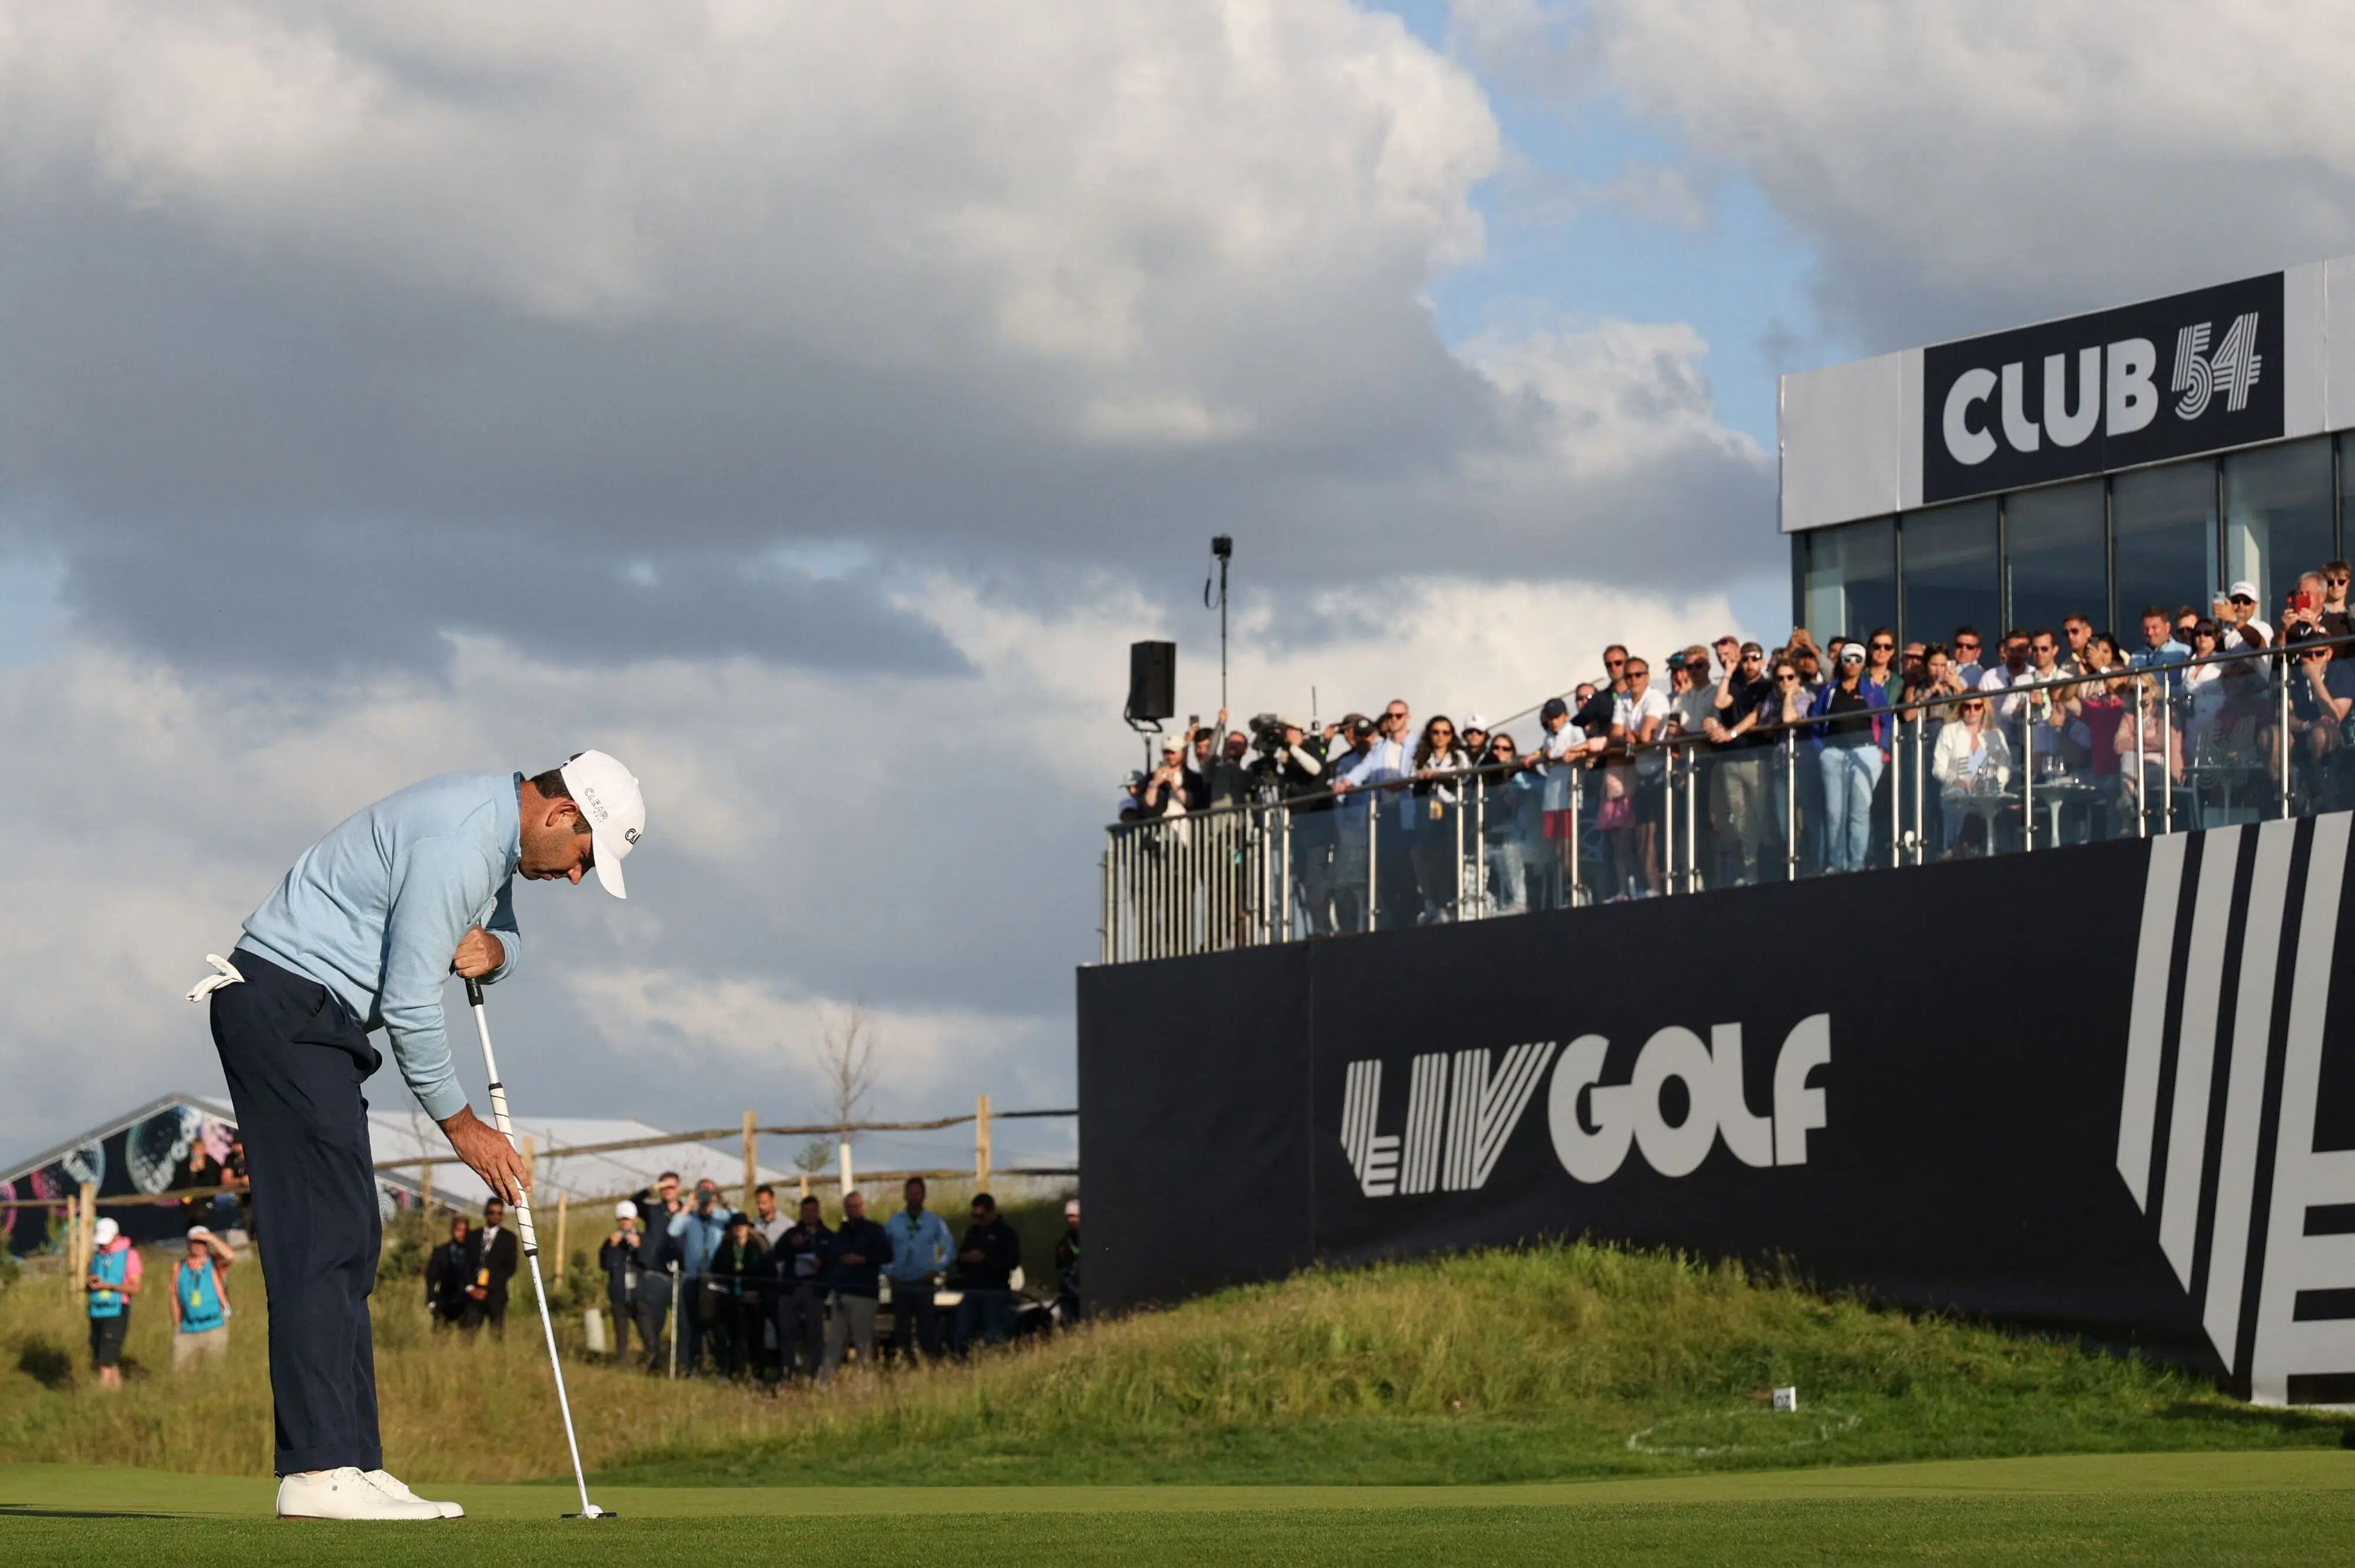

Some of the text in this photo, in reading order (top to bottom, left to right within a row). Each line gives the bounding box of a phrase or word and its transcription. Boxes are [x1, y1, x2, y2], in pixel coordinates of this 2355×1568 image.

[1943, 312, 2262, 465] CLUB 54
[585, 788, 609, 822] CLEAR
[1340, 1013, 1831, 1198] LIV GOLF
